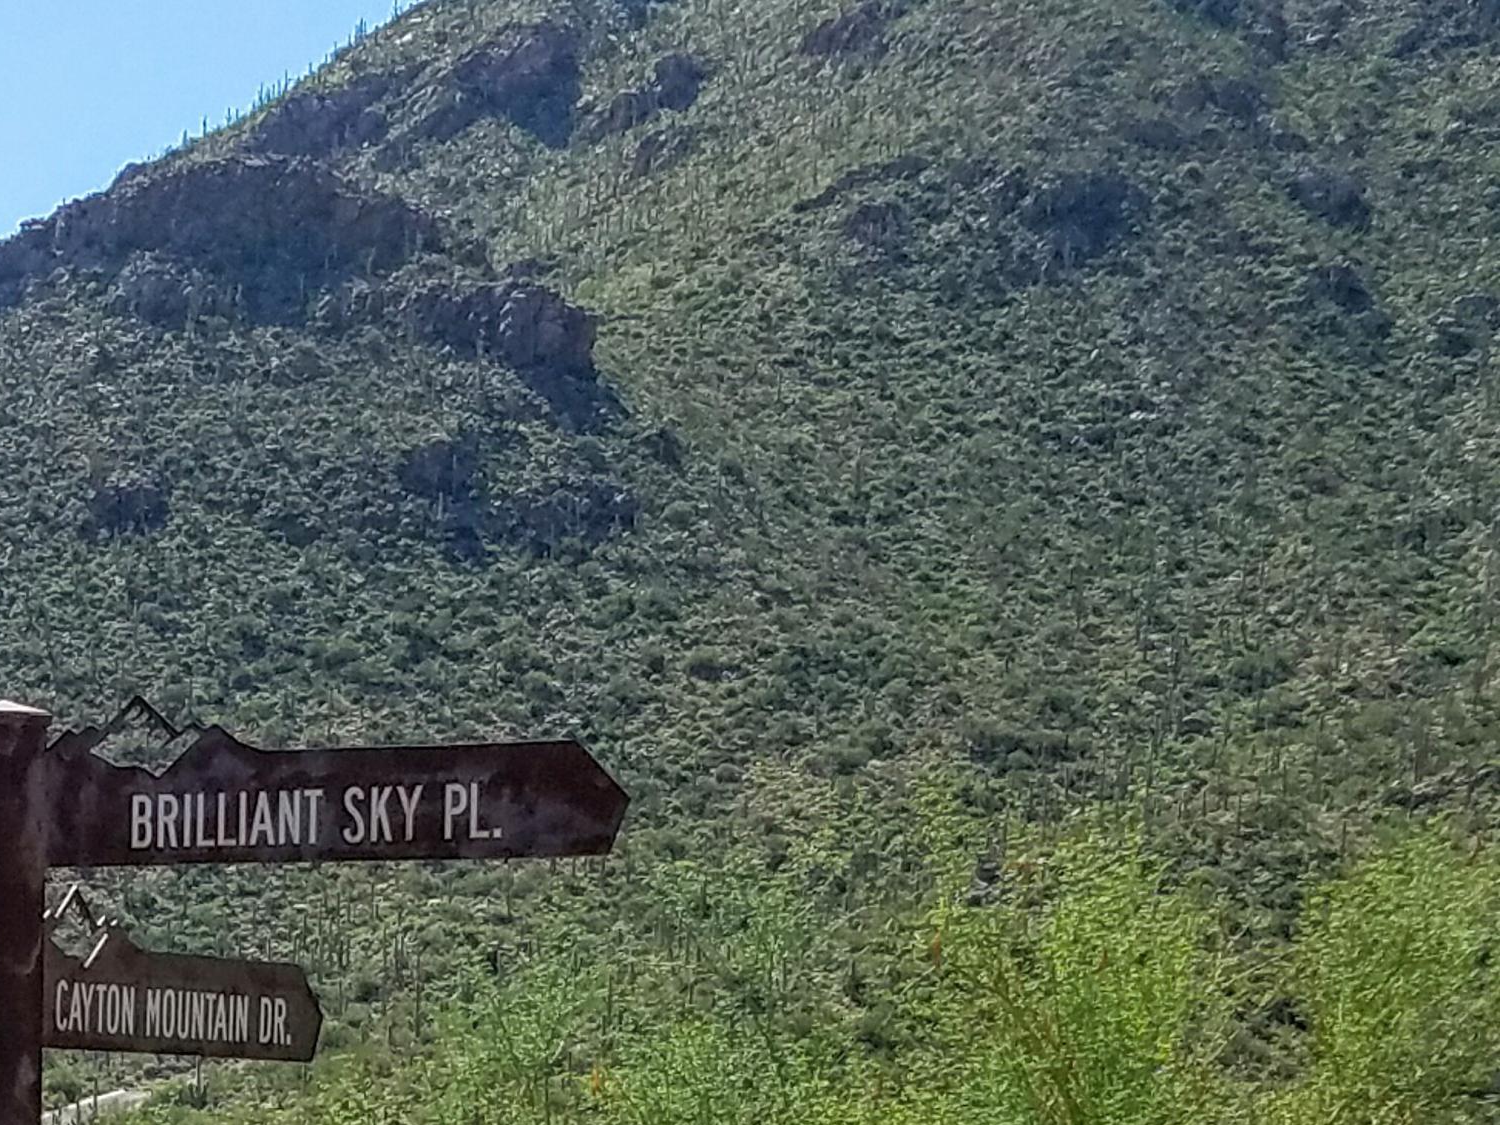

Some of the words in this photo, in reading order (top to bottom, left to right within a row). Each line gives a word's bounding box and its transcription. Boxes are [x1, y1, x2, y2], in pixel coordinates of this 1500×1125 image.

[131, 787, 323, 850] BRILLIANT
[343, 783, 424, 844] SKY
[444, 782, 503, 840] PL.
[54, 979, 135, 1036] CAYTON
[145, 988, 249, 1045] MOUNTAIN
[258, 996, 293, 1046] DR.
